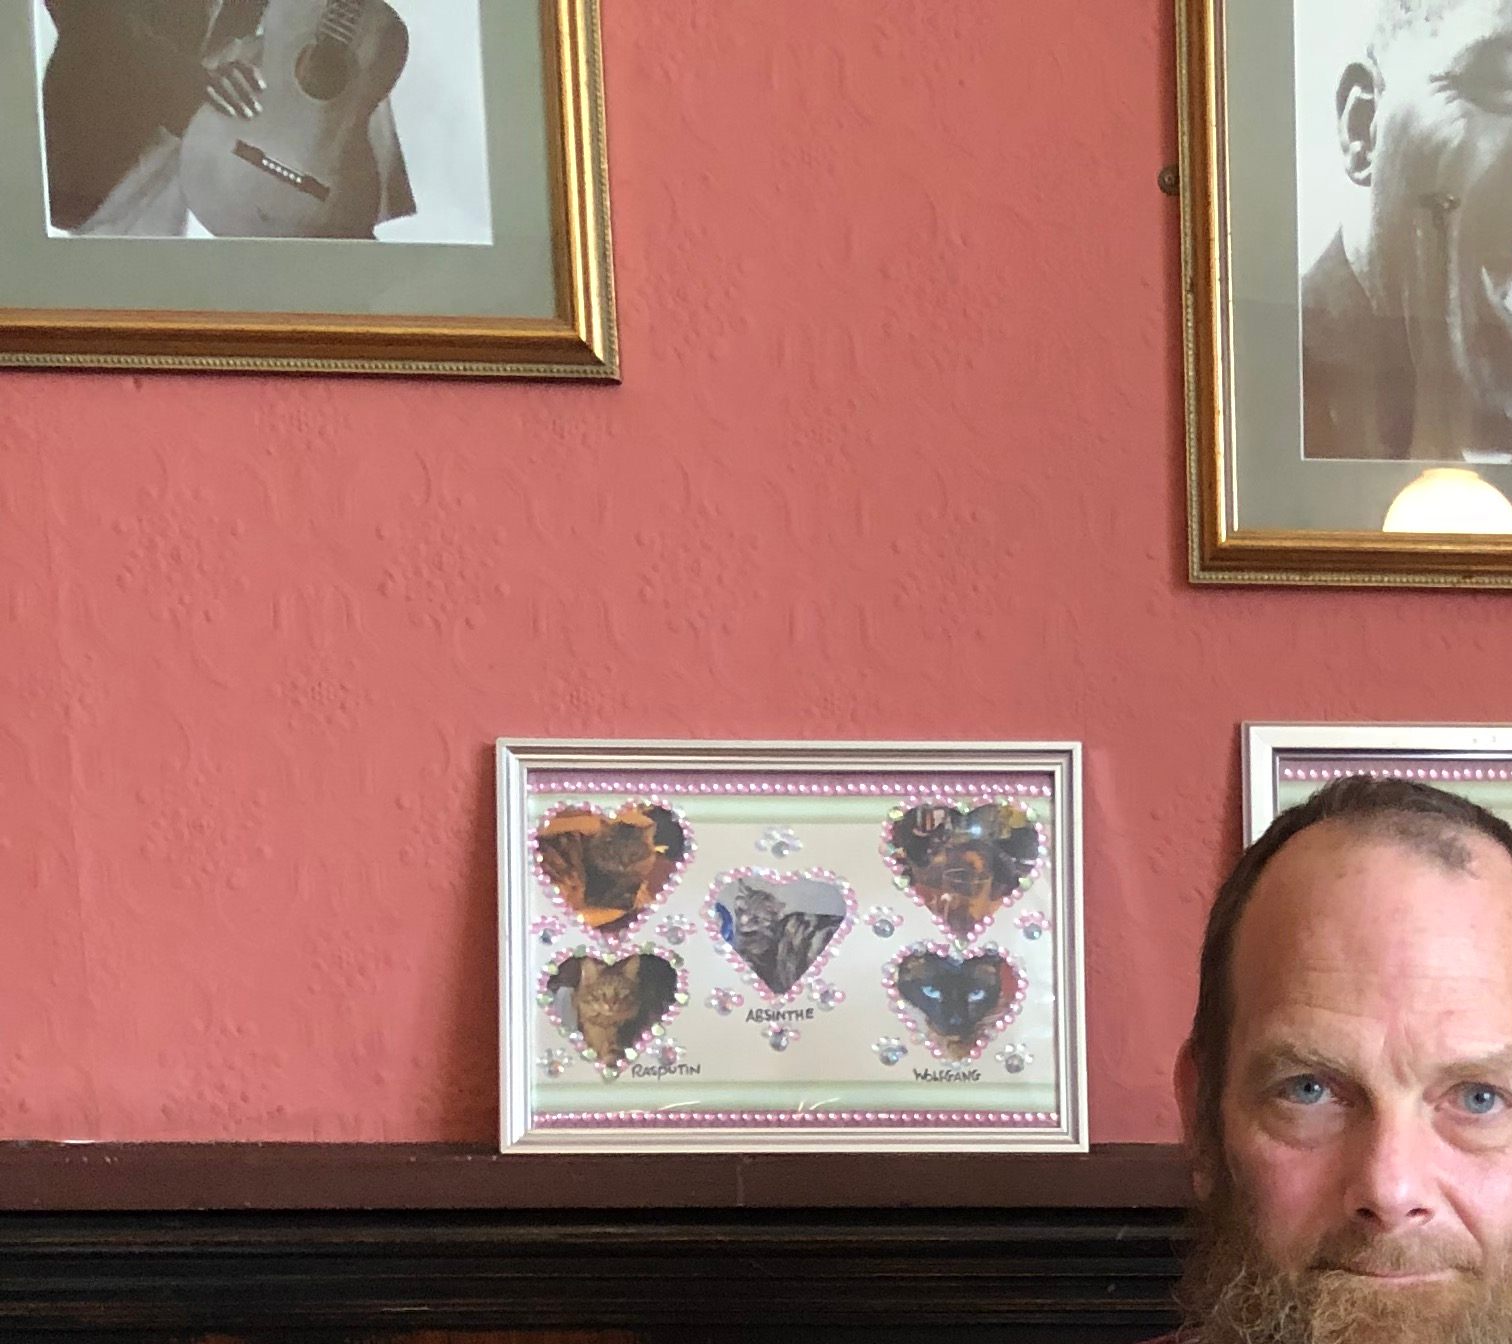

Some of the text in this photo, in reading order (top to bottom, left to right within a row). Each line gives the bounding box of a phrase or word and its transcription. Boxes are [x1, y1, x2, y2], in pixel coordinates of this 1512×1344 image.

[745, 1007, 815, 1023] ABSINTHE
[631, 1063, 701, 1081] RASPUTIN
[913, 1067, 982, 1082] WOLFGANG
